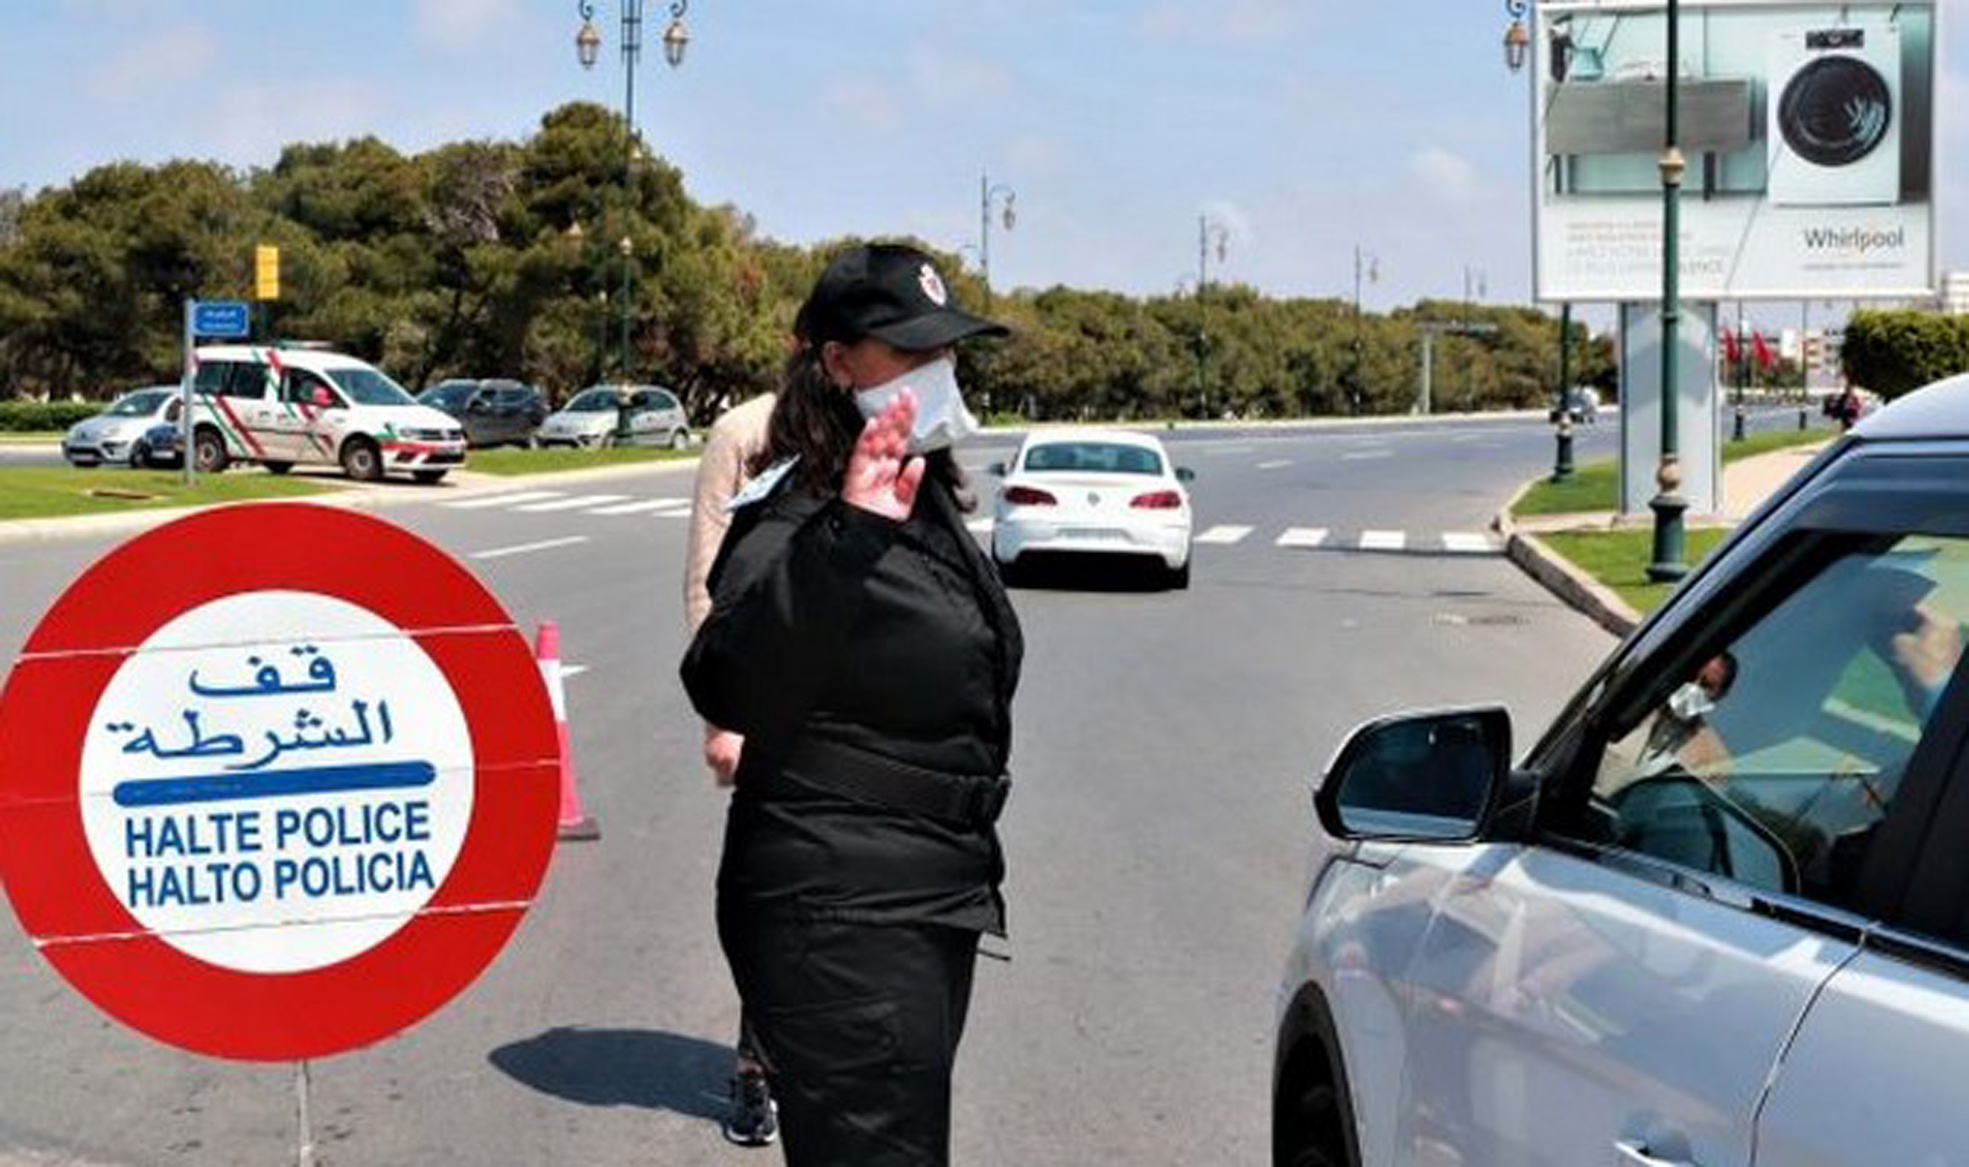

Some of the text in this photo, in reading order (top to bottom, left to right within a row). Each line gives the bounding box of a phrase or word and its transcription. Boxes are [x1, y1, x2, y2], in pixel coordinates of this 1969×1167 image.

[1803, 226, 1904, 253] Whirlpool
[189, 645, 336, 697] قف
[106, 699, 393, 770] الشرطة
[126, 801, 430, 858] HALTE POLICE
[127, 850, 435, 908] HALTO POLICIA
